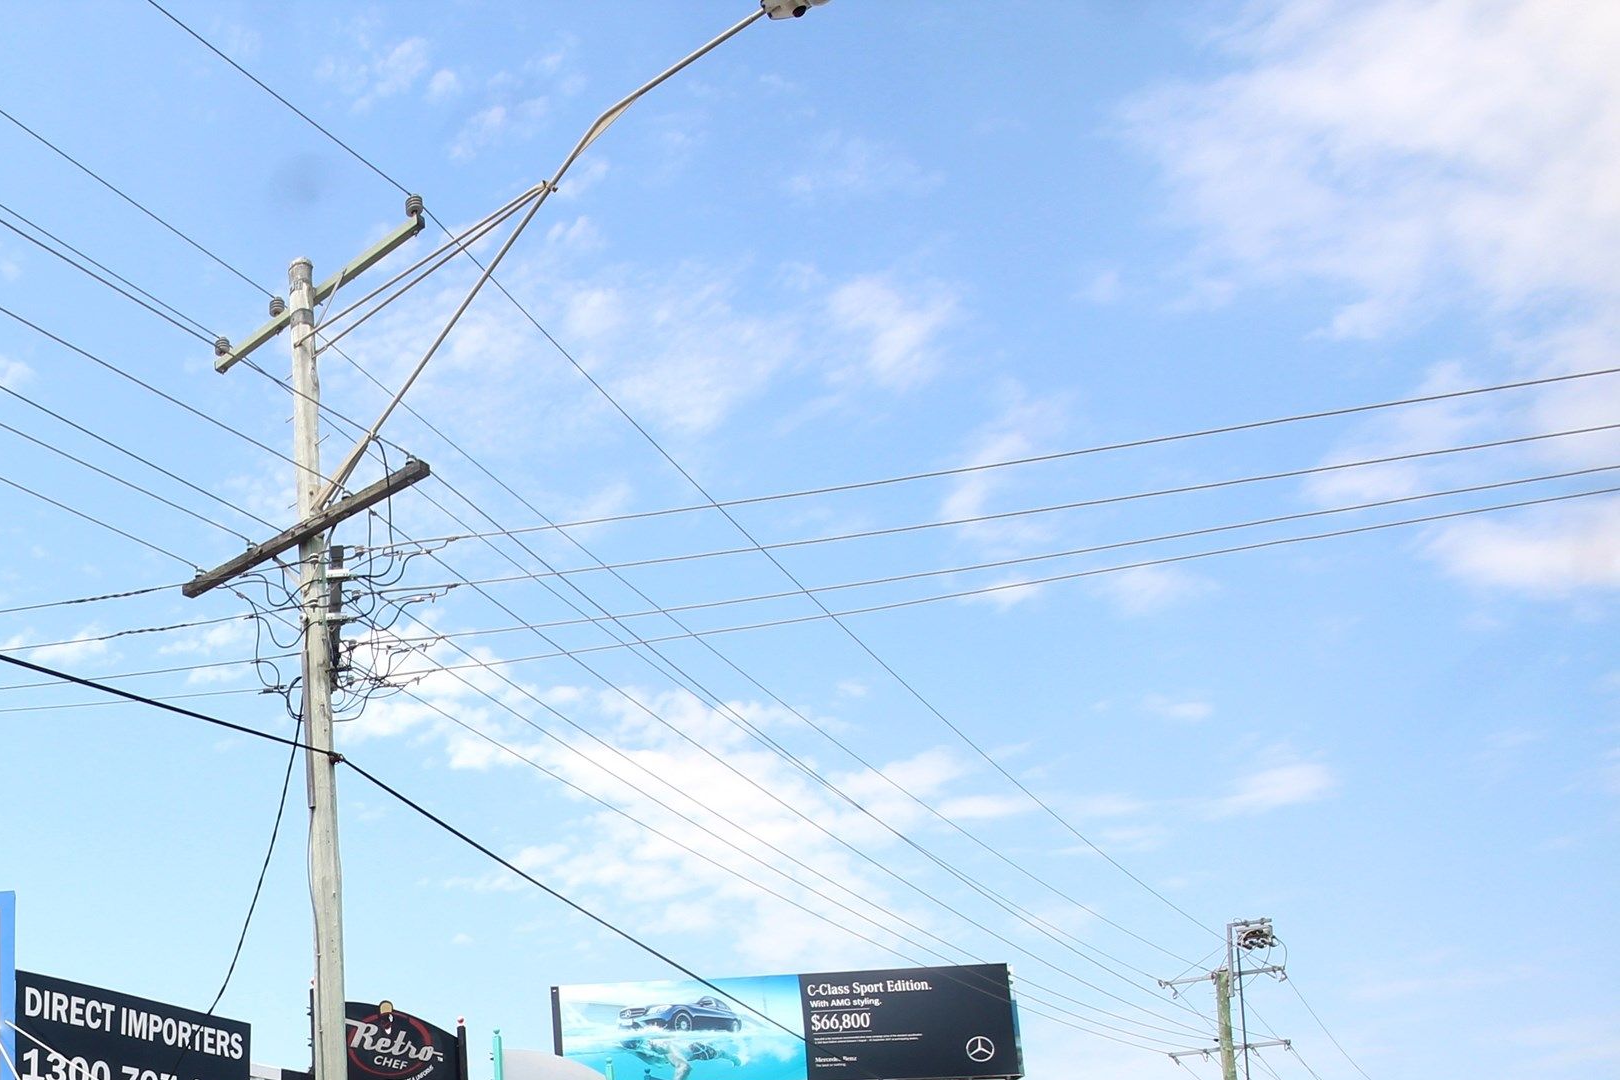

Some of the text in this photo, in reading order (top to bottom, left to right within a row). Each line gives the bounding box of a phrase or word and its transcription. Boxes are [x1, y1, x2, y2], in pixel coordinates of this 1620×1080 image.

[807, 979, 932, 997] C-Class Sport Edition.
[810, 997, 882, 1008] With AMG styling.
[25, 987, 244, 1060] DIRECT IMPORTERS
[344, 1017, 443, 1061] Retro
[374, 1055, 408, 1070] CHEF
